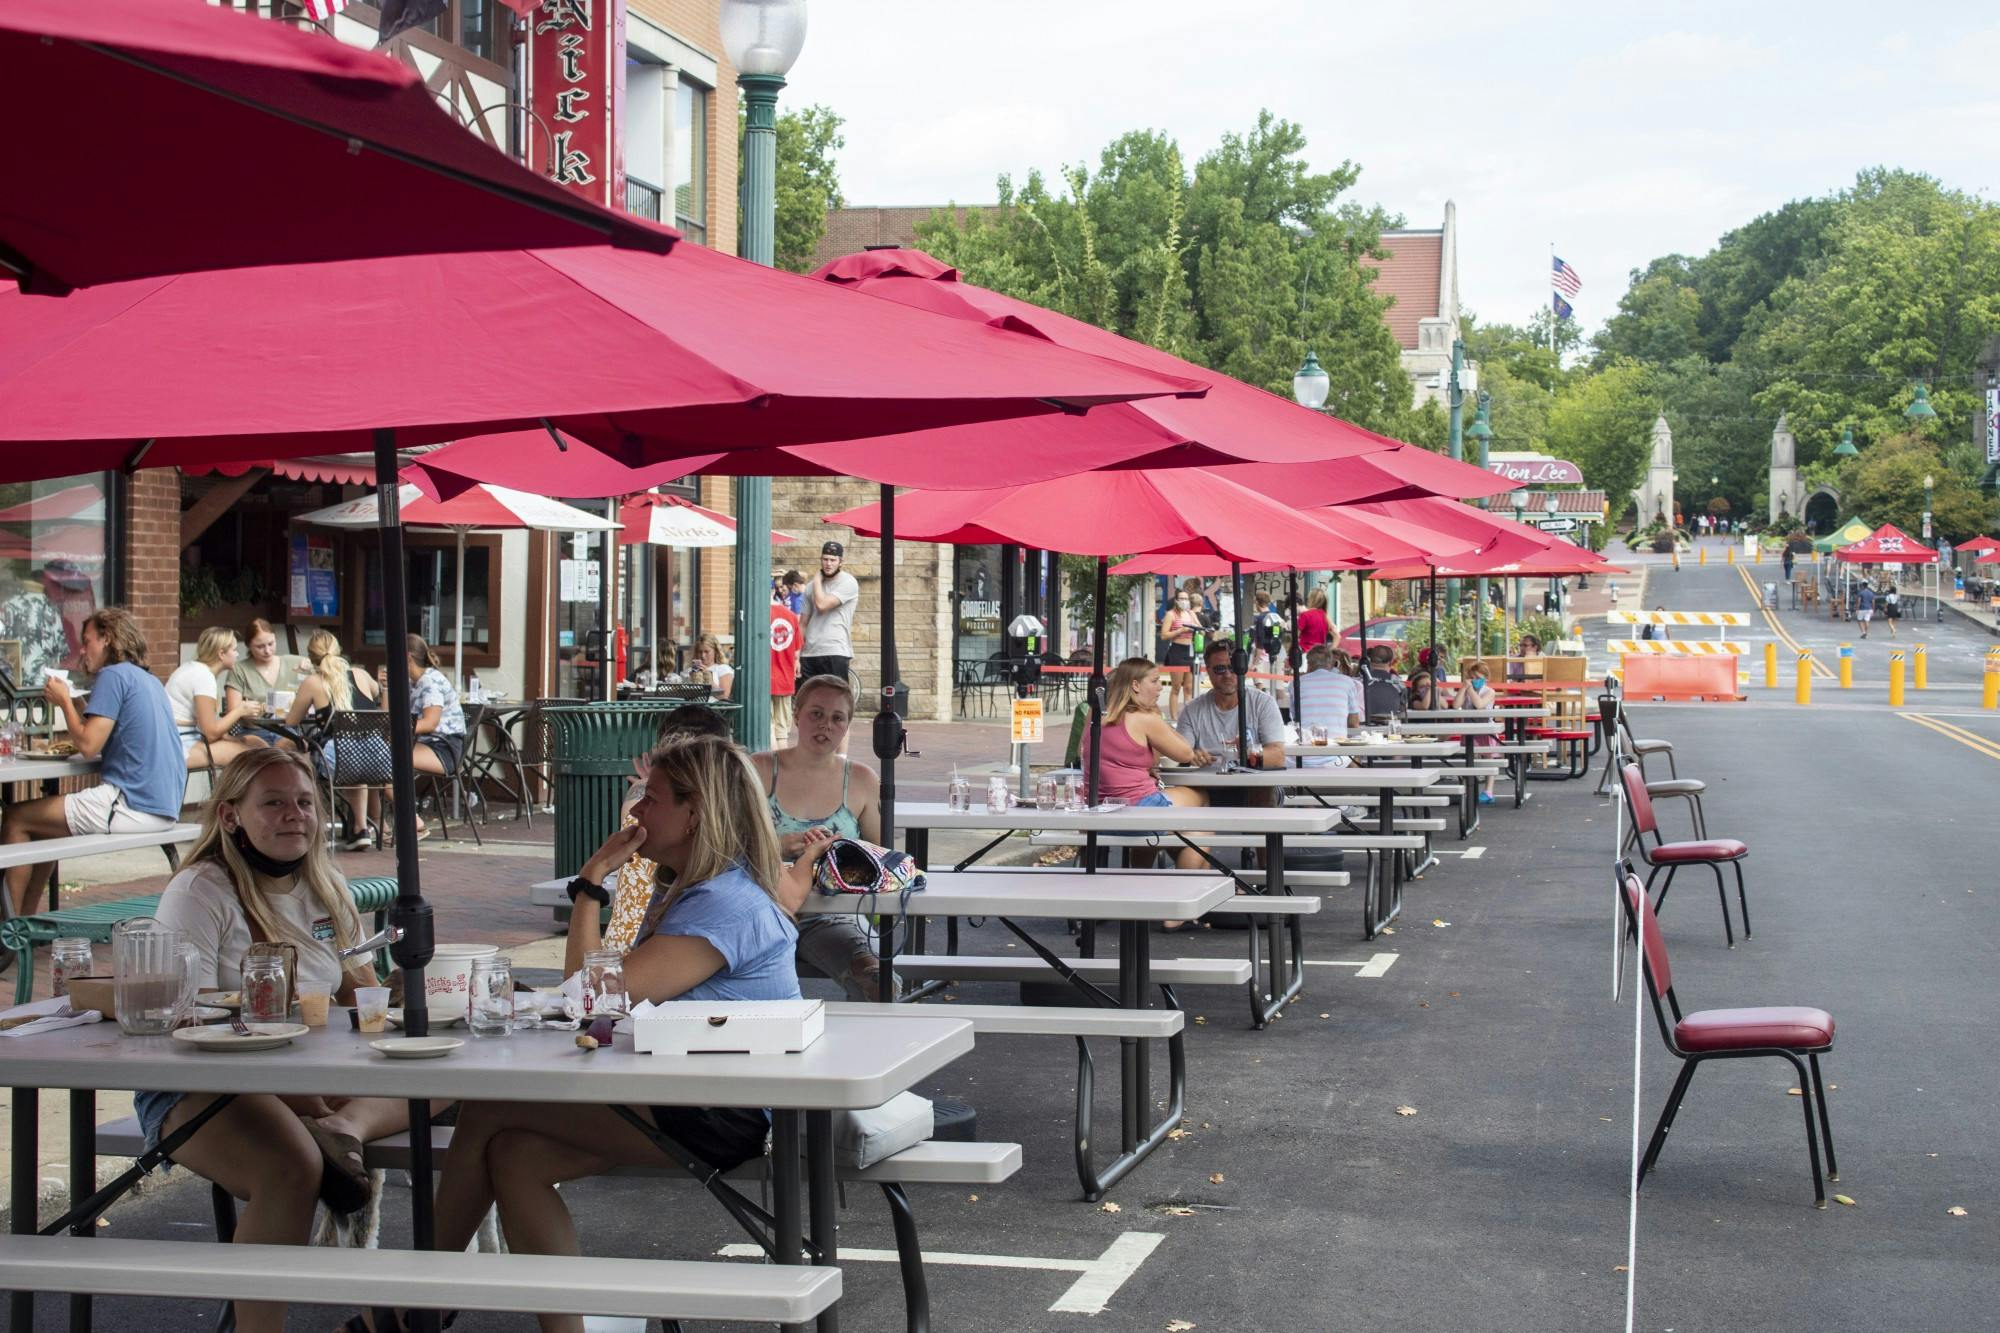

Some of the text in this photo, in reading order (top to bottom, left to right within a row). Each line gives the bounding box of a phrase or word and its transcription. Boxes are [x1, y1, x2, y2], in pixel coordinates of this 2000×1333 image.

[1489, 462, 1568, 480] Von Lee
[961, 600, 1000, 619] GOODFELLAS
